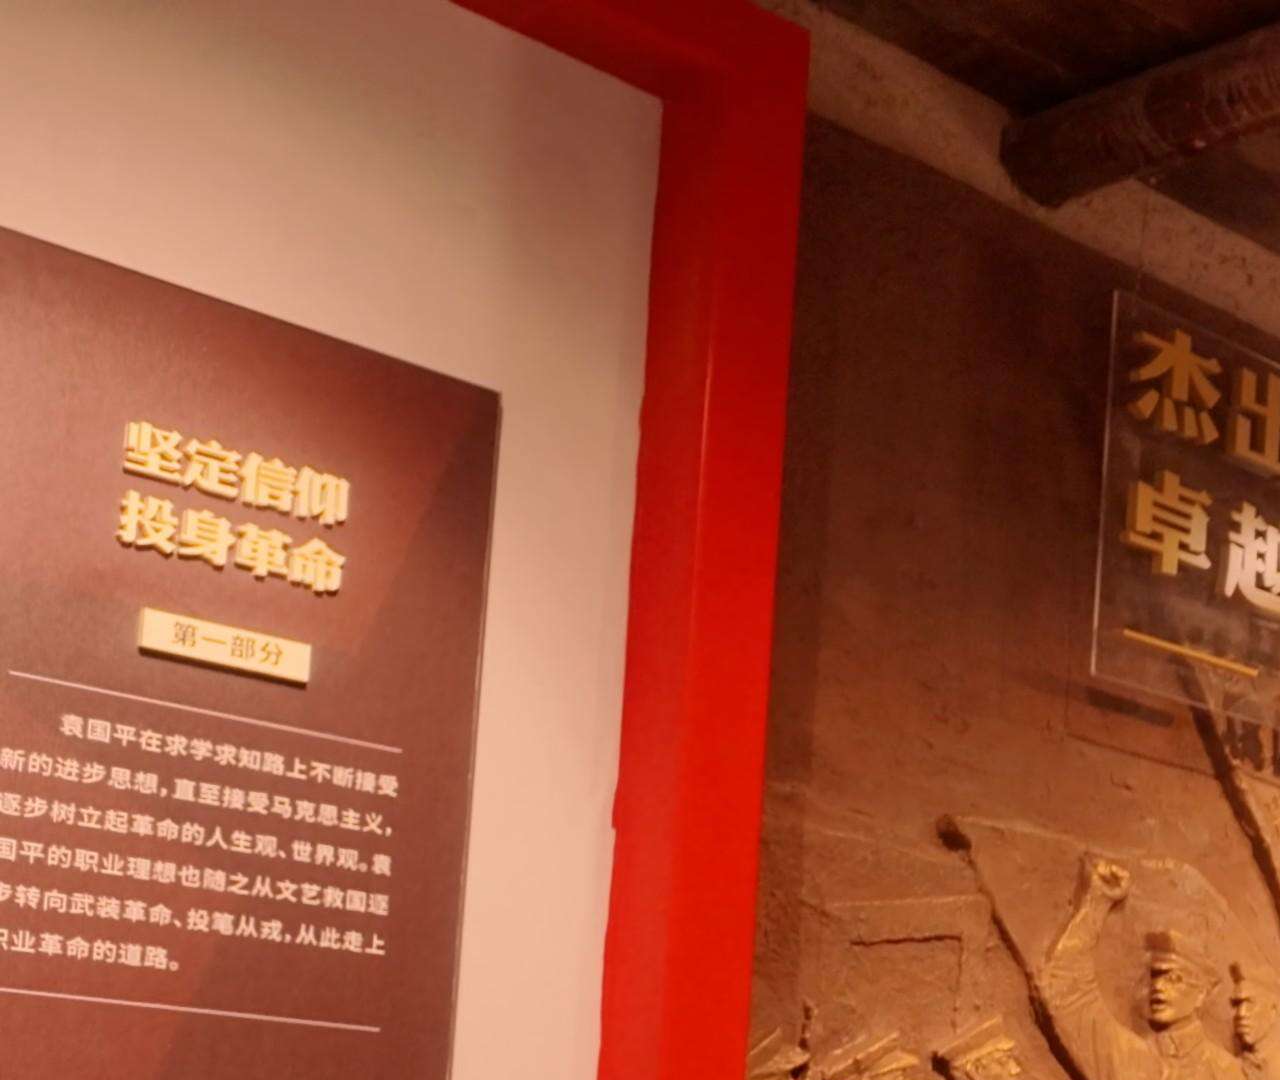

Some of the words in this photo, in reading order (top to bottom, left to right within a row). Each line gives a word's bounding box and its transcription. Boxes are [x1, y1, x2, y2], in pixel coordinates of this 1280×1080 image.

[122, 421, 351, 526] 坚定信仰
[116, 489, 347, 596] 投身革命
[171, 620, 285, 667] 第一部分
[59, 713, 399, 798] 袁国平在求学求知路上不断接受
